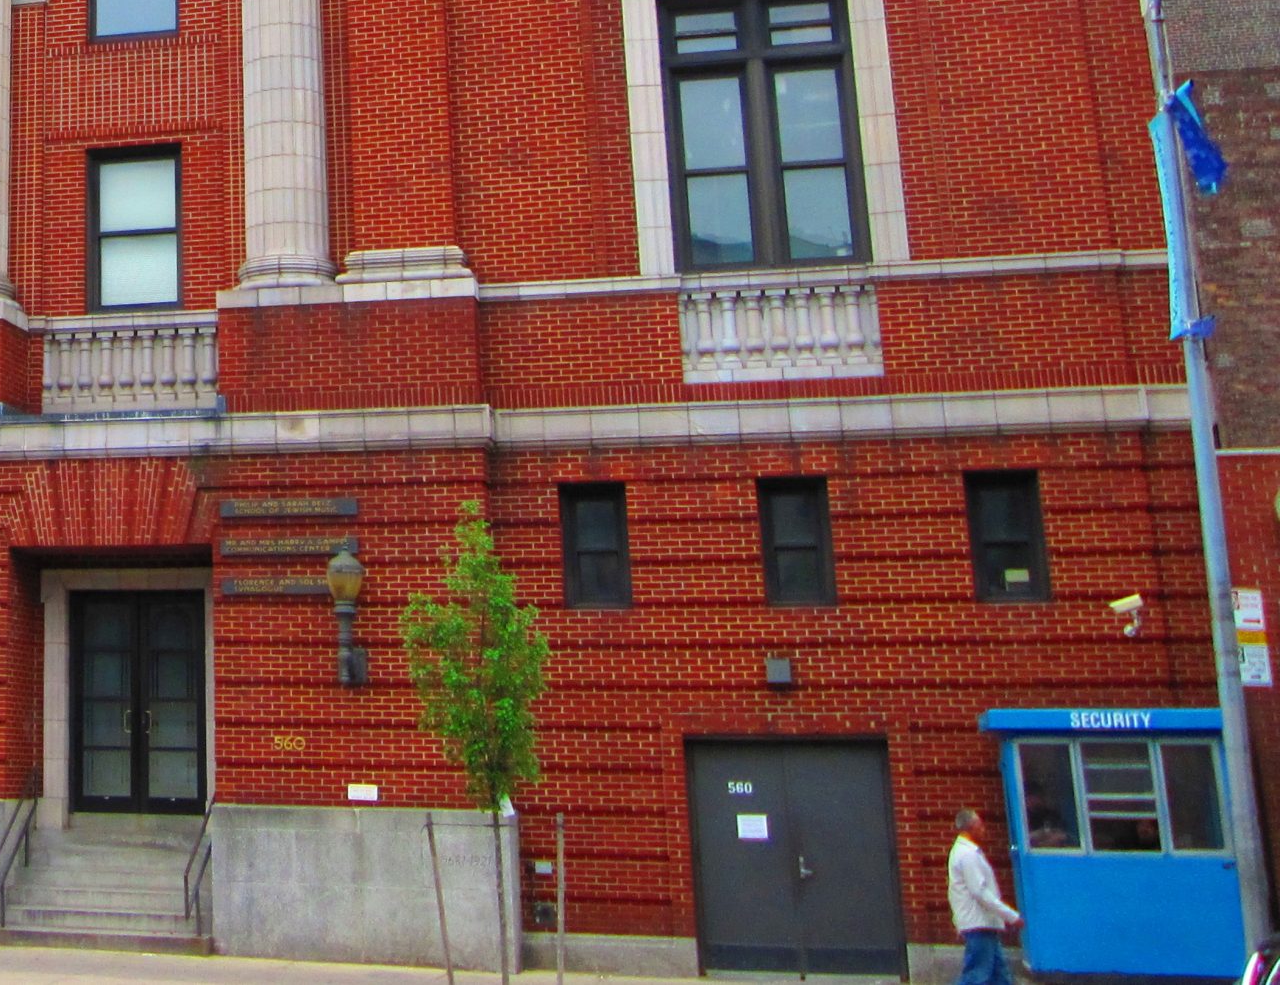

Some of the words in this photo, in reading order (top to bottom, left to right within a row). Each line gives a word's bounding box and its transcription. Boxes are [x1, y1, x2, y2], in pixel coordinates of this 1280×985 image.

[261, 500, 279, 508] AND
[1070, 712, 1151, 729] SECURITY
[274, 736, 306, 751] 560
[727, 781, 753, 794] 560
